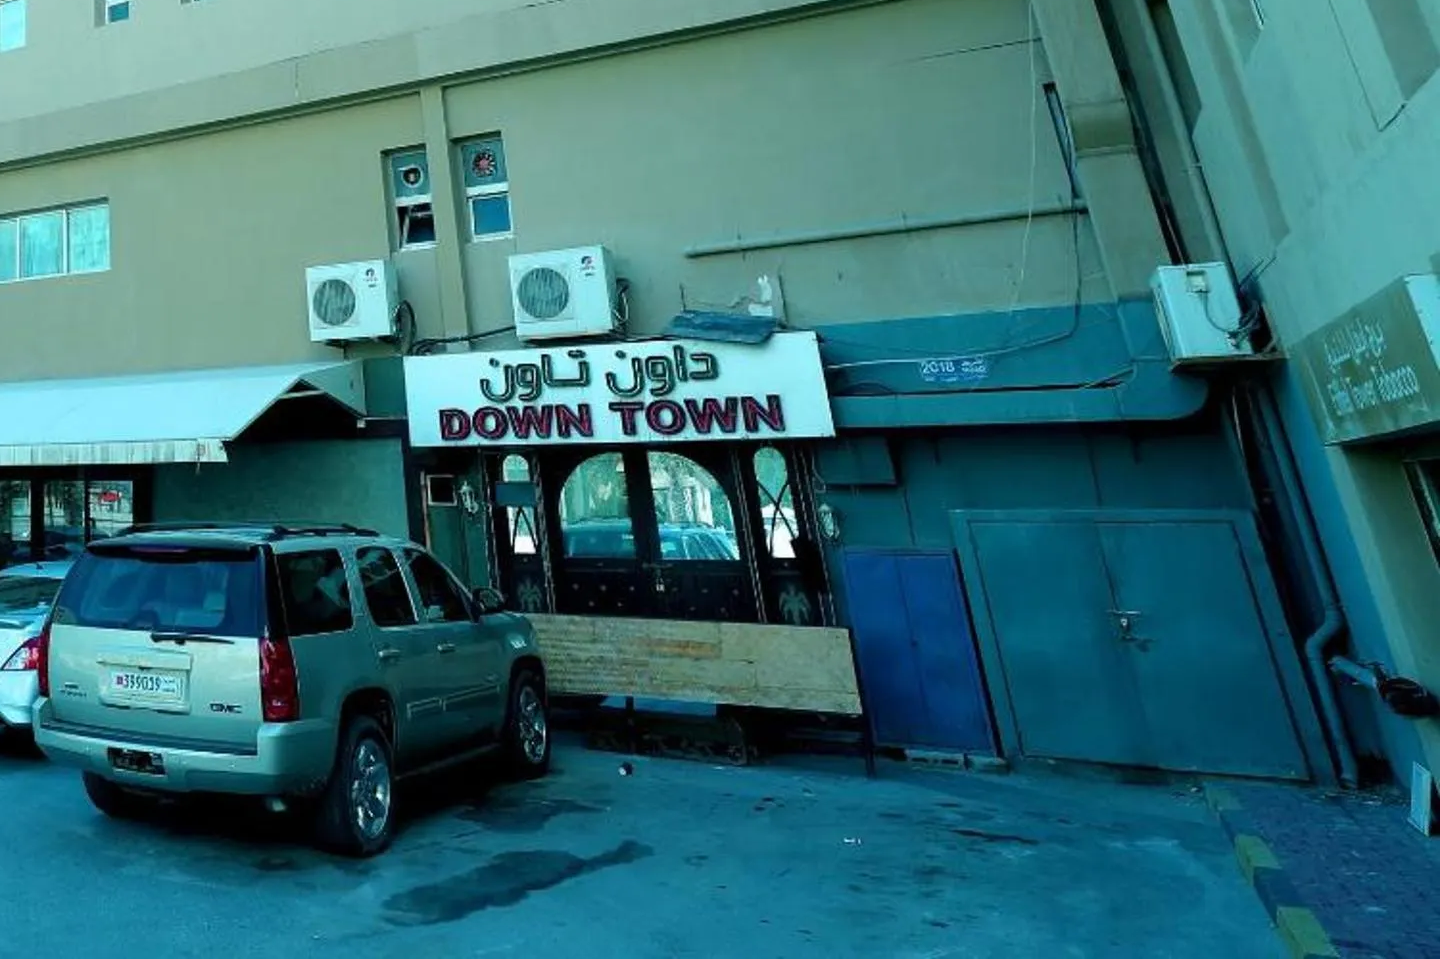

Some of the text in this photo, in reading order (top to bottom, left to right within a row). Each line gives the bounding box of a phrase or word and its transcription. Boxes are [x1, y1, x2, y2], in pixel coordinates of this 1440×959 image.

[479, 345, 721, 403] داون تاون
[439, 394, 786, 441] DOWN TOWN
[210, 703, 242, 714] GMC
